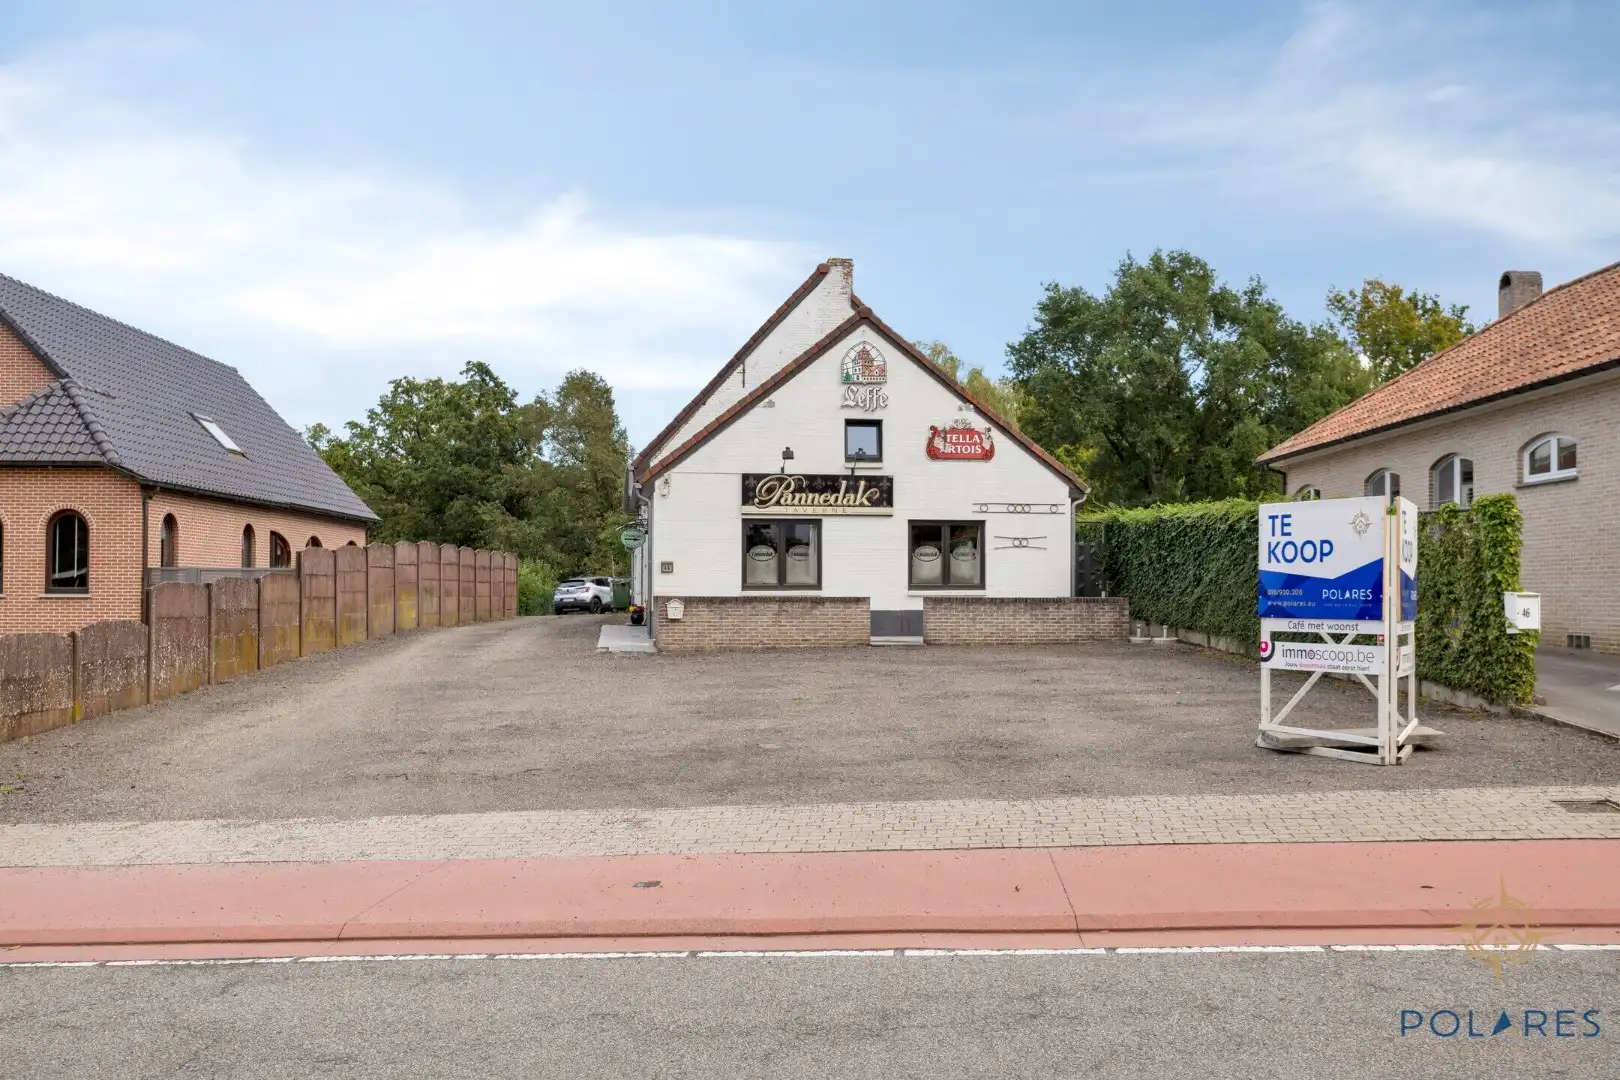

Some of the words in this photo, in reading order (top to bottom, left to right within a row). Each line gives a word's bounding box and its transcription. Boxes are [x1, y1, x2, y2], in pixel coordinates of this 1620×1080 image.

[841, 385, 888, 411] Leffe
[754, 475, 879, 508] Pannedak
[1268, 513, 1292, 537] TE
[1267, 539, 1334, 564] KOOP
[1267, 600, 1316, 608] www.polares.eu
[1322, 589, 1373, 600] POLARES
[1522, 608, 1530, 617] 46
[1287, 620, 1305, 632] Café
[1308, 622, 1325, 631] met
[1327, 622, 1359, 632] woonst
[1281, 645, 1375, 665] immoscoop.be
